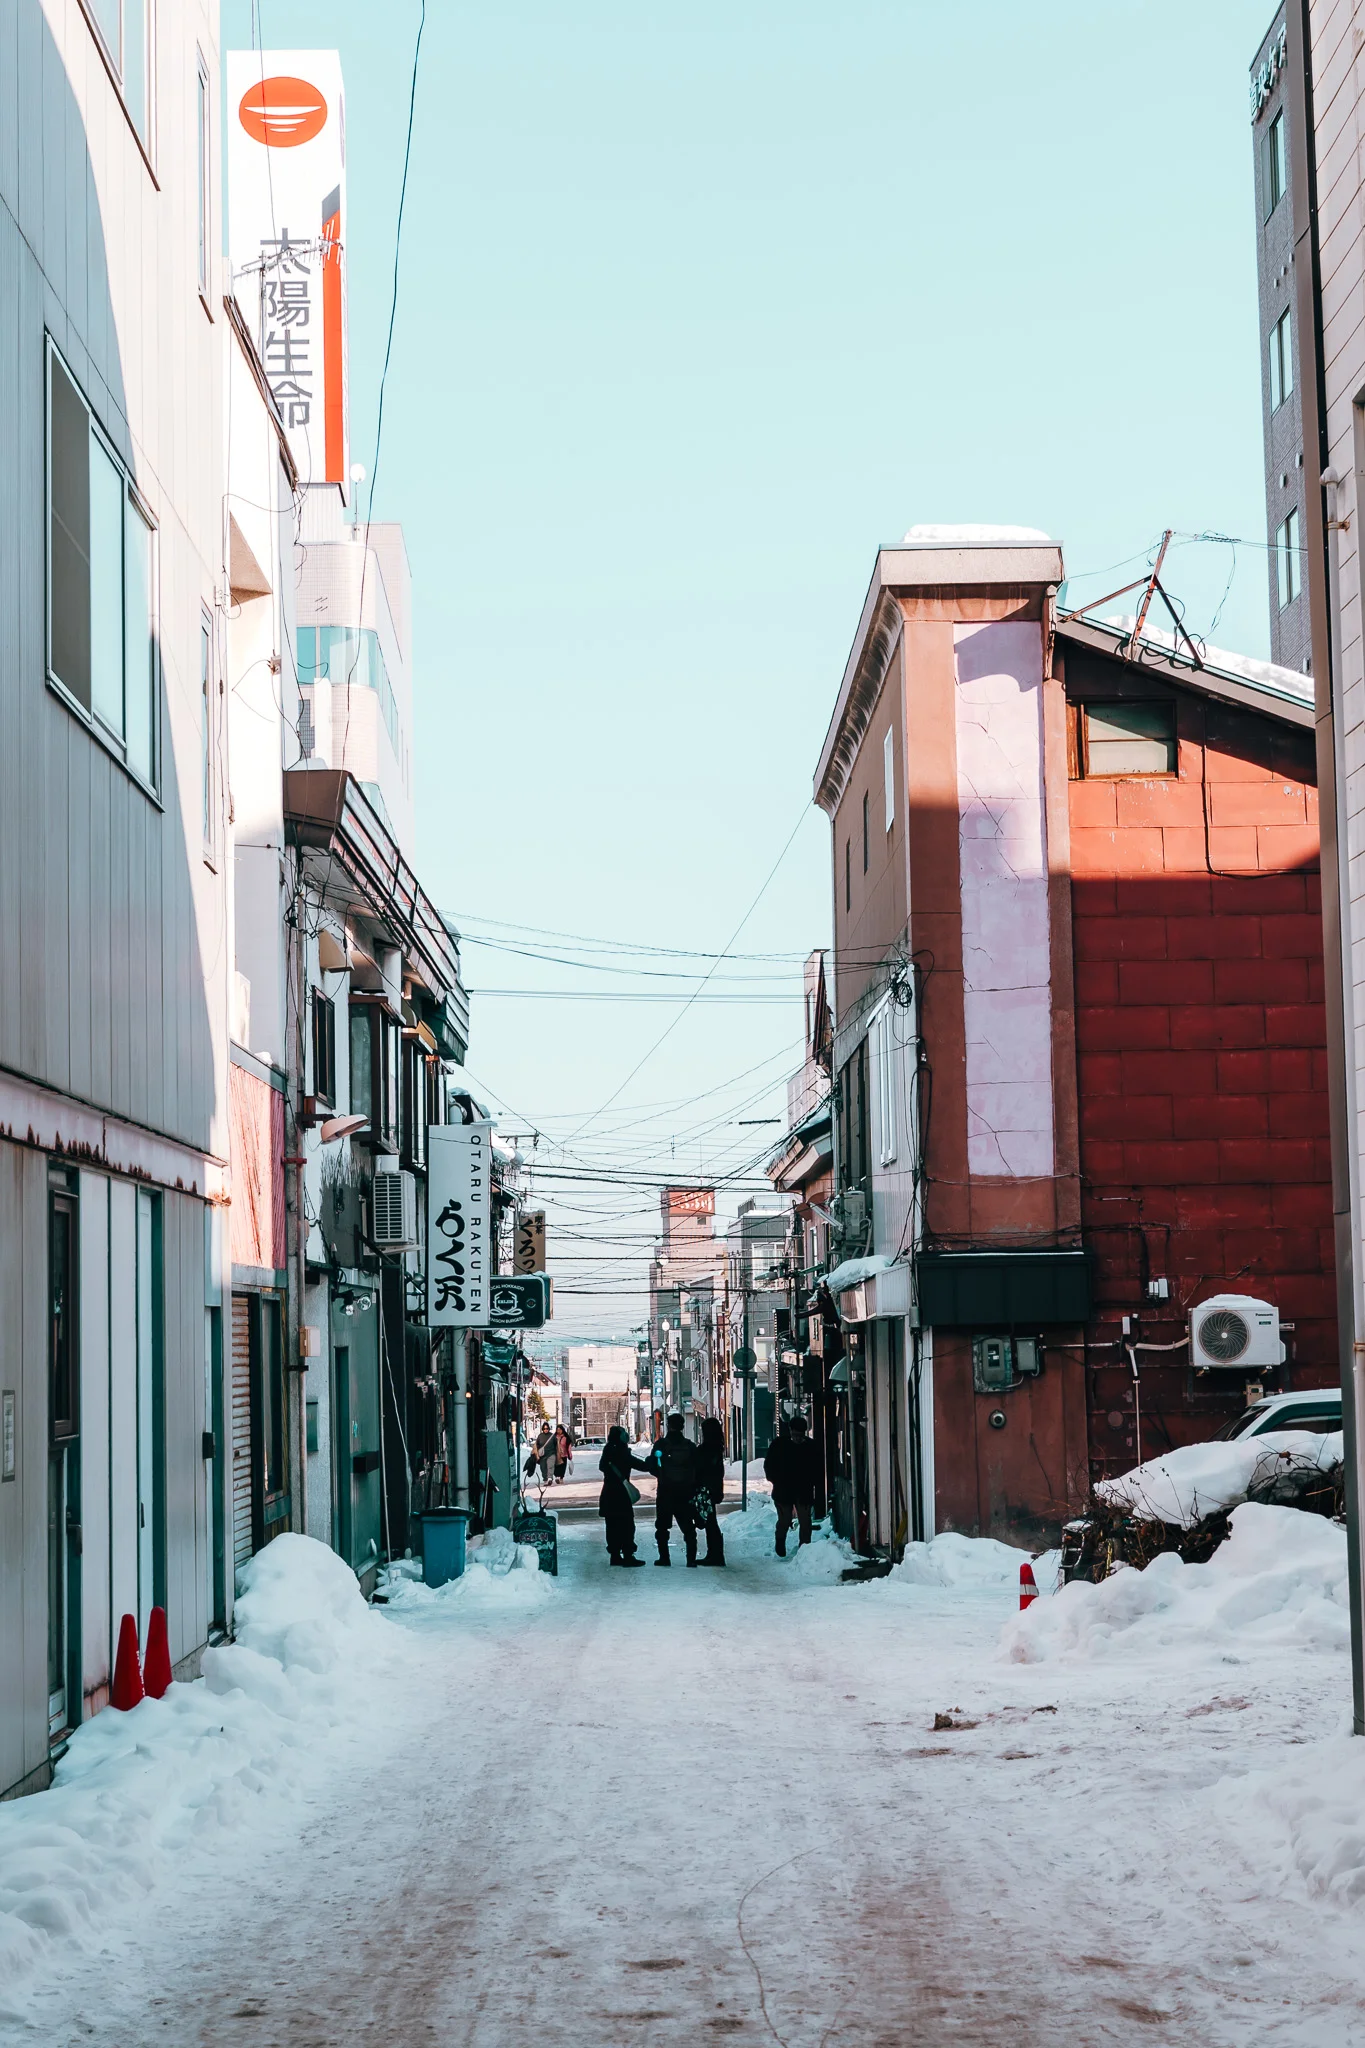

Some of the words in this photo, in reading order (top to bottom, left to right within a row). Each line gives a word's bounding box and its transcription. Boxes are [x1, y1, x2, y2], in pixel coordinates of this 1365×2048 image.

[260, 227, 313, 429] 太陽生命
[470, 1135, 482, 1203] OTARU
[435, 1198, 466, 1312] らく天
[470, 1217, 482, 1312] RAKUTEN
[518, 1218, 536, 1270] くろっ
